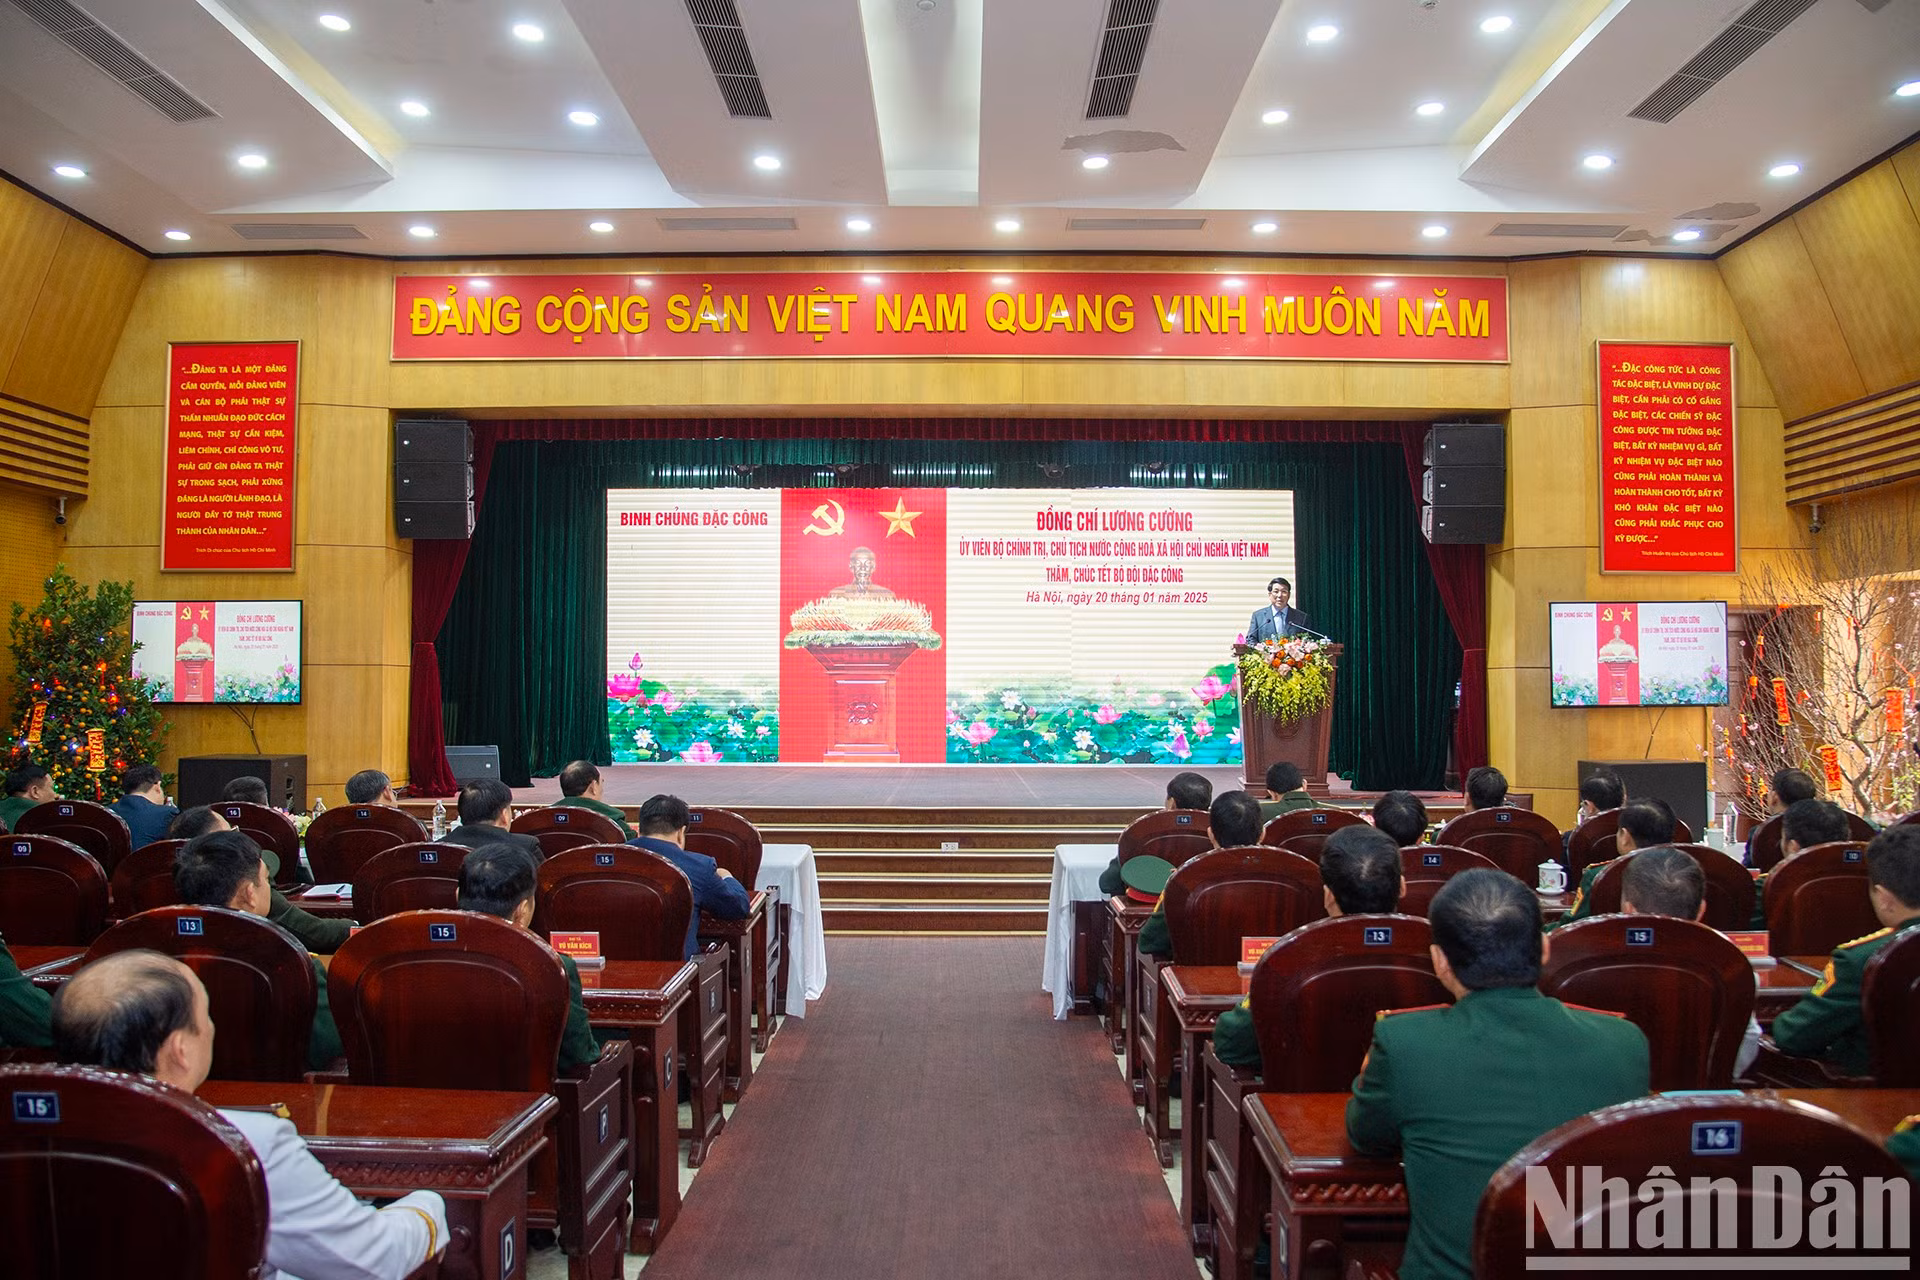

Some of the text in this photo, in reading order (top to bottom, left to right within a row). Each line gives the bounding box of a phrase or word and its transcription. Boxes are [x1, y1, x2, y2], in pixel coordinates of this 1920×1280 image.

[410, 284, 1489, 342] ĐẢNG CỘNG SẢN VIỆT NAM QUANG VINH MUÔN NĂM
[620, 506, 768, 528] BINH CHỦNG ĐẶC CÔNG
[1037, 505, 1193, 531] ĐỒNG CHÍ LƯƠNG CƯỜNG
[972, 538, 991, 556] VIÊN
[993, 538, 1004, 559] BỘ
[1006, 538, 1031, 556] CHÍNH
[1033, 541, 1048, 559] TRỊ,
[1051, 537, 1067, 556] CHỦ
[1069, 541, 1087, 559] TỊCH
[1089, 538, 1111, 556] NƯỚC
[1113, 539, 1136, 560] CỘNG
[1170, 539, 1183, 560] HỘI
[1185, 538, 1202, 557] CHỦ
[1204, 539, 1229, 557] NGHĨA
[1231, 539, 1248, 560] VIỆT
[1250, 542, 1269, 557] NAM
[1045, 563, 1183, 585] THĂM, CHÚC TẾT BỘ ĐỘI ĐẶC CÔNG
[1026, 591, 1208, 605] Hà Nội, ngày 20 tháng 01 năm 2025
[18, 845, 28, 853] 09
[425, 853, 434, 861] 13
[601, 856, 611, 864] 15
[185, 922, 196, 931] 13
[438, 928, 449, 938] 15
[1373, 931, 1384, 941] 13
[1635, 932, 1645, 942] 15
[666, 1058, 673, 1081] C
[26, 1098, 48, 1117] 15
[600, 1113, 608, 1136] P
[1706, 1128, 1728, 1148] 16
[504, 1233, 512, 1270] D
